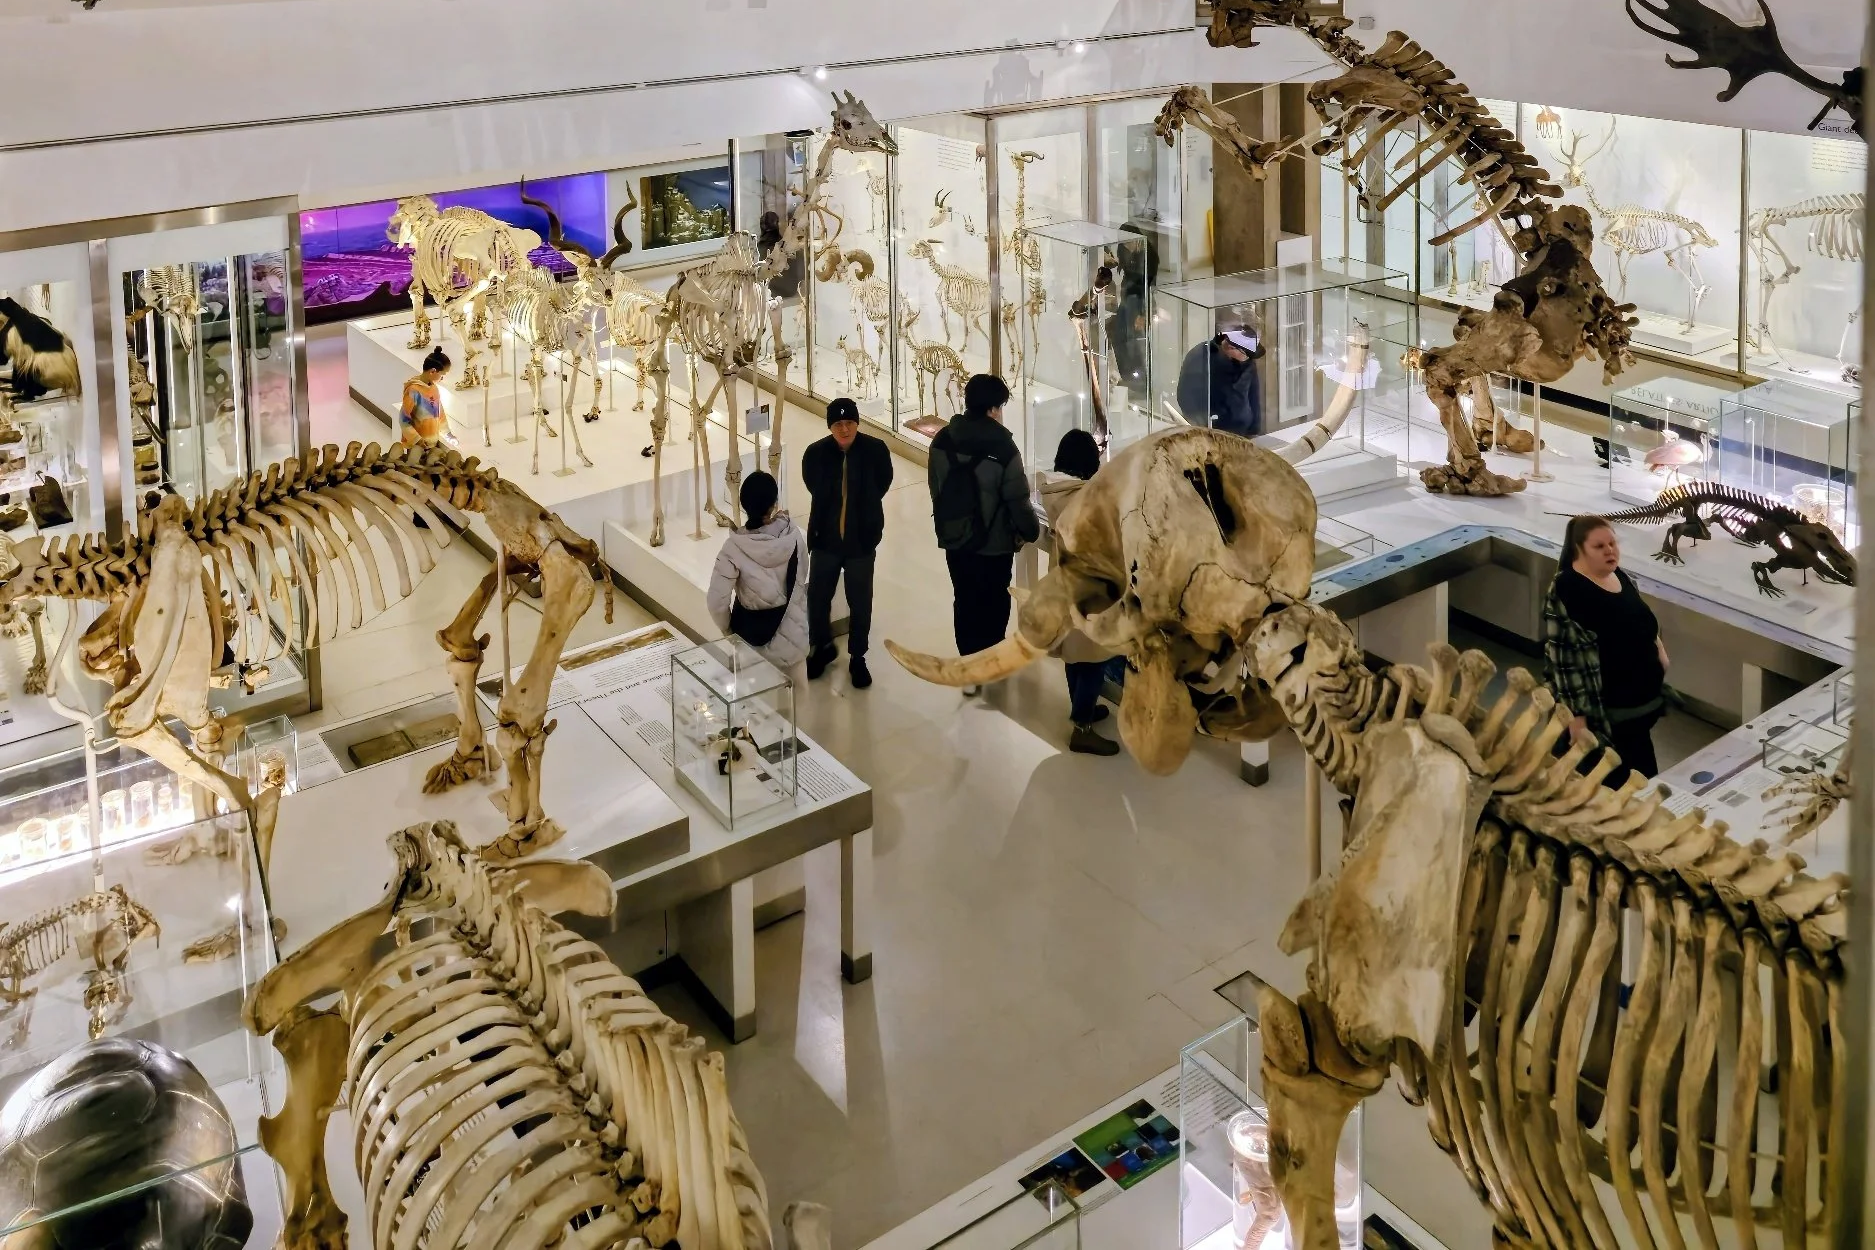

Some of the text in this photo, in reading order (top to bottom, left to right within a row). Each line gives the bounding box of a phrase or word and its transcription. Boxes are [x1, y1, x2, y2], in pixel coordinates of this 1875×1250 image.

[1818, 122, 1841, 133] Giant
[625, 681, 640, 690] and
[610, 686, 624, 695] the
